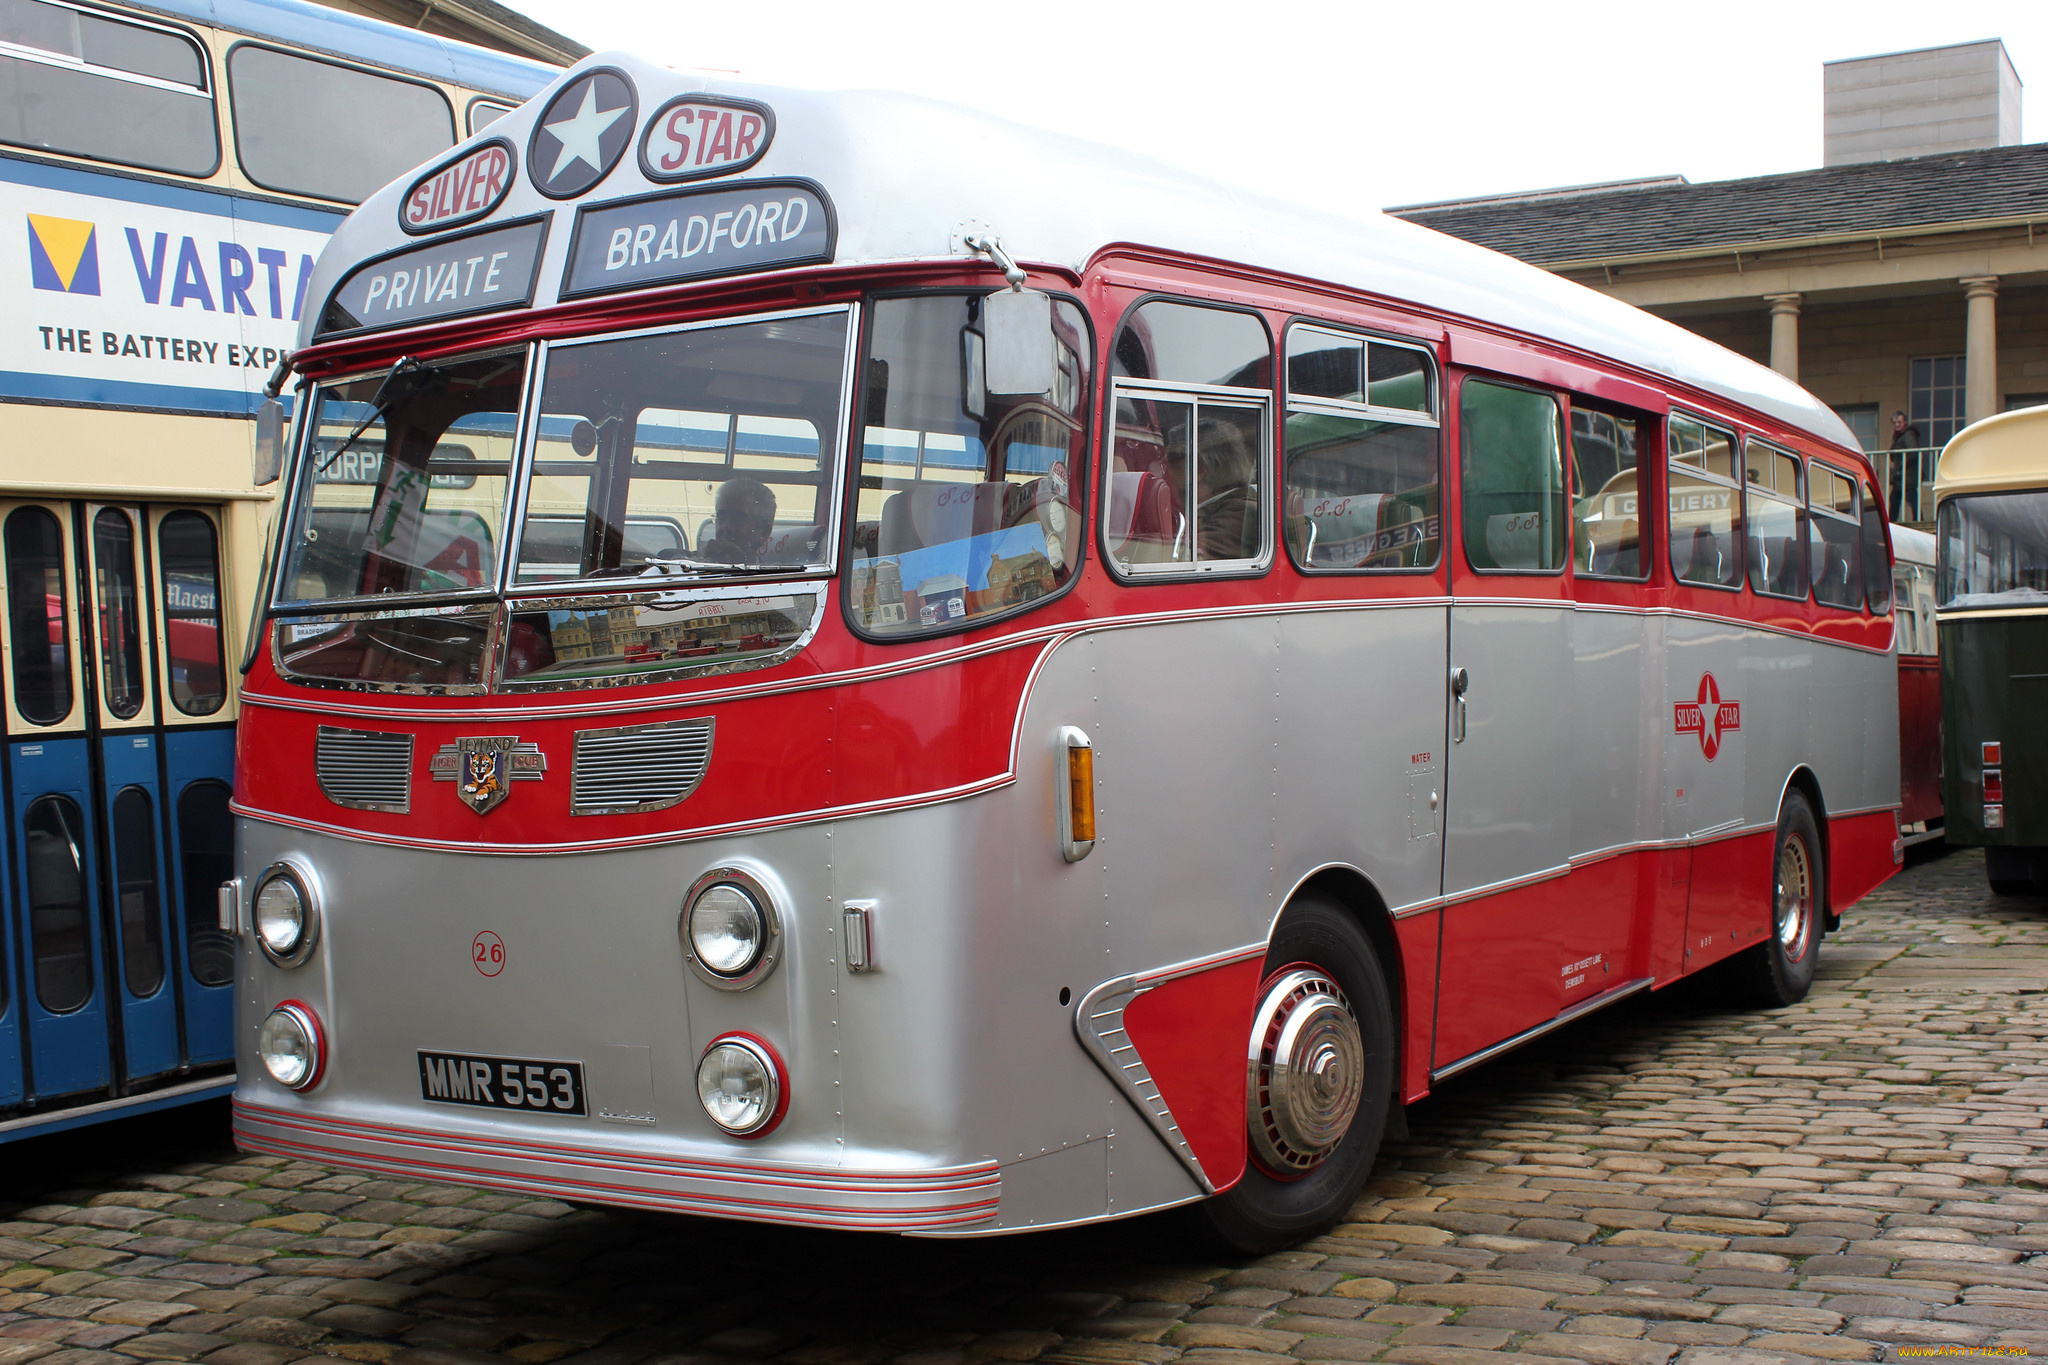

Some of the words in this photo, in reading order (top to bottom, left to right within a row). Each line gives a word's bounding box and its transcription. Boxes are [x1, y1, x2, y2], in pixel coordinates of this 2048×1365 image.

[410, 148, 506, 222] SILVER
[661, 108, 762, 171] STAR
[605, 197, 809, 271] BRADFORD
[363, 251, 508, 314] PRIVATE
[38, 326, 92, 353] THE
[103, 331, 218, 364] BATTERY
[698, 604, 727, 617] RIBBLE
[1676, 708, 1701, 728] SILVER
[1720, 707, 1739, 725] STAR
[459, 738, 511, 752] LEYLAND
[432, 756, 457, 768] TIGER
[516, 756, 539, 768] CUB
[1411, 752, 1432, 764] WATER
[475, 942, 502, 963] 26
[425, 1057, 495, 1103] MMR
[501, 1064, 575, 1110] 553
